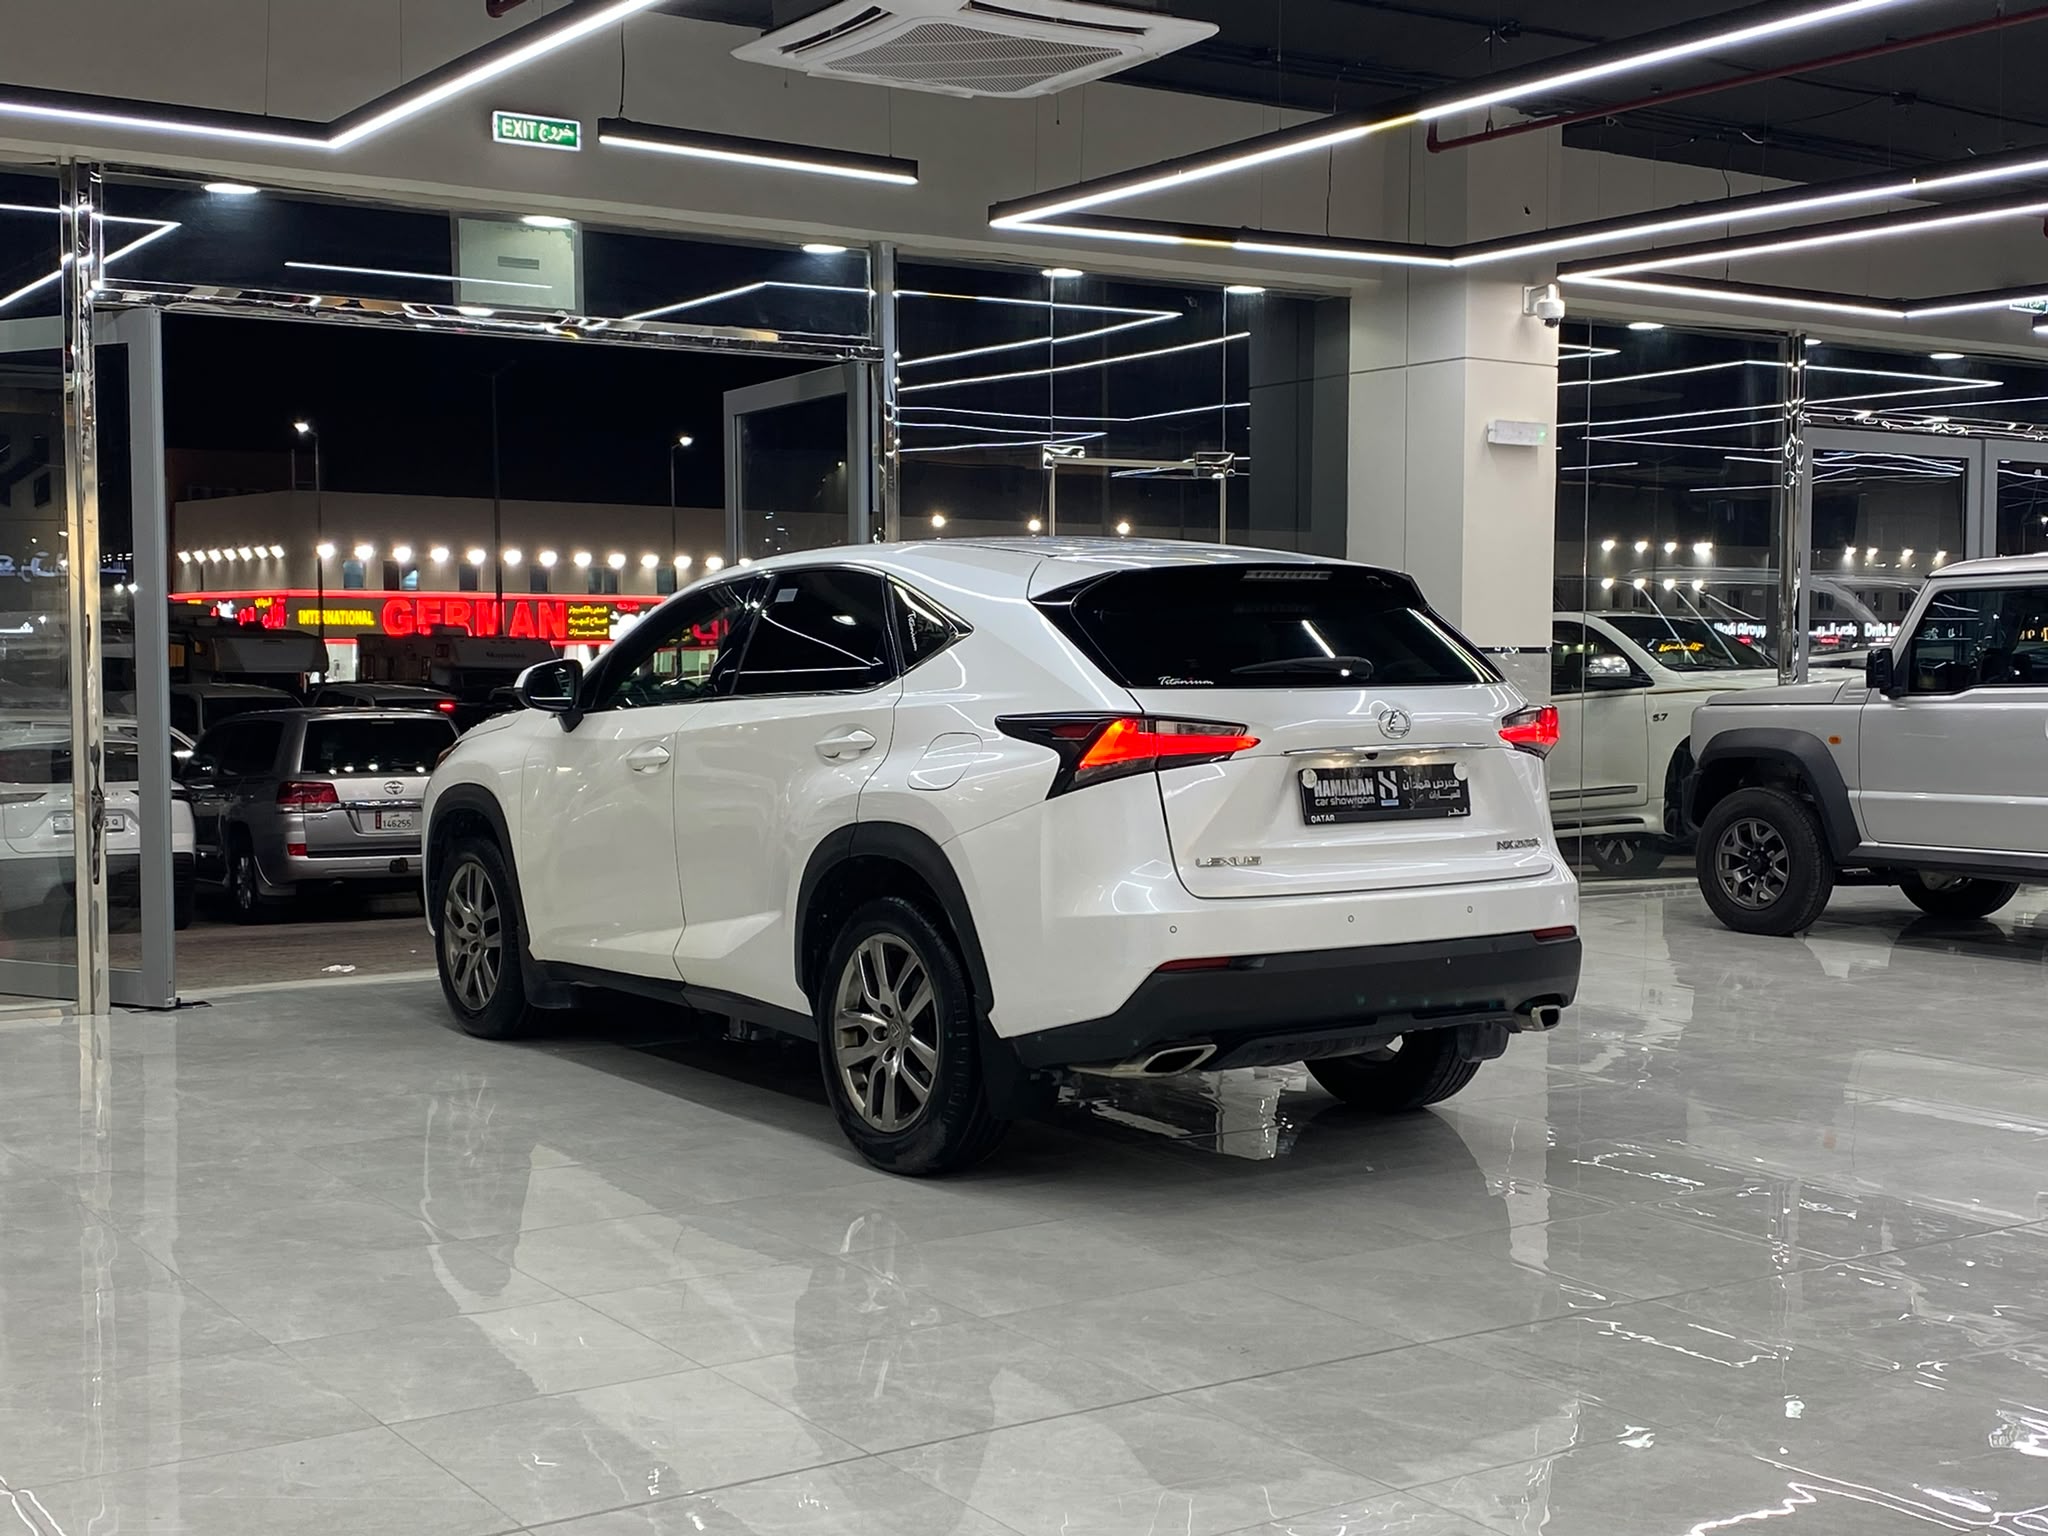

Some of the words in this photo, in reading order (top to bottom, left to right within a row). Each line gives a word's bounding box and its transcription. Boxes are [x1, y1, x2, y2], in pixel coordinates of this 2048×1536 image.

[502, 118, 537, 139] EXIT
[538, 123, 575, 142] خروج
[298, 609, 375, 625] INTERNATIONAL
[382, 598, 566, 640] GERMAN
[1157, 675, 1215, 686] Titanium
[1313, 777, 1375, 798] HAMADAN
[1314, 798, 1329, 807] car
[1330, 795, 1376, 807] showroom
[1310, 813, 1336, 824] QATAR
[1447, 807, 1468, 817] قطر
[1195, 855, 1262, 868] LEXUS
